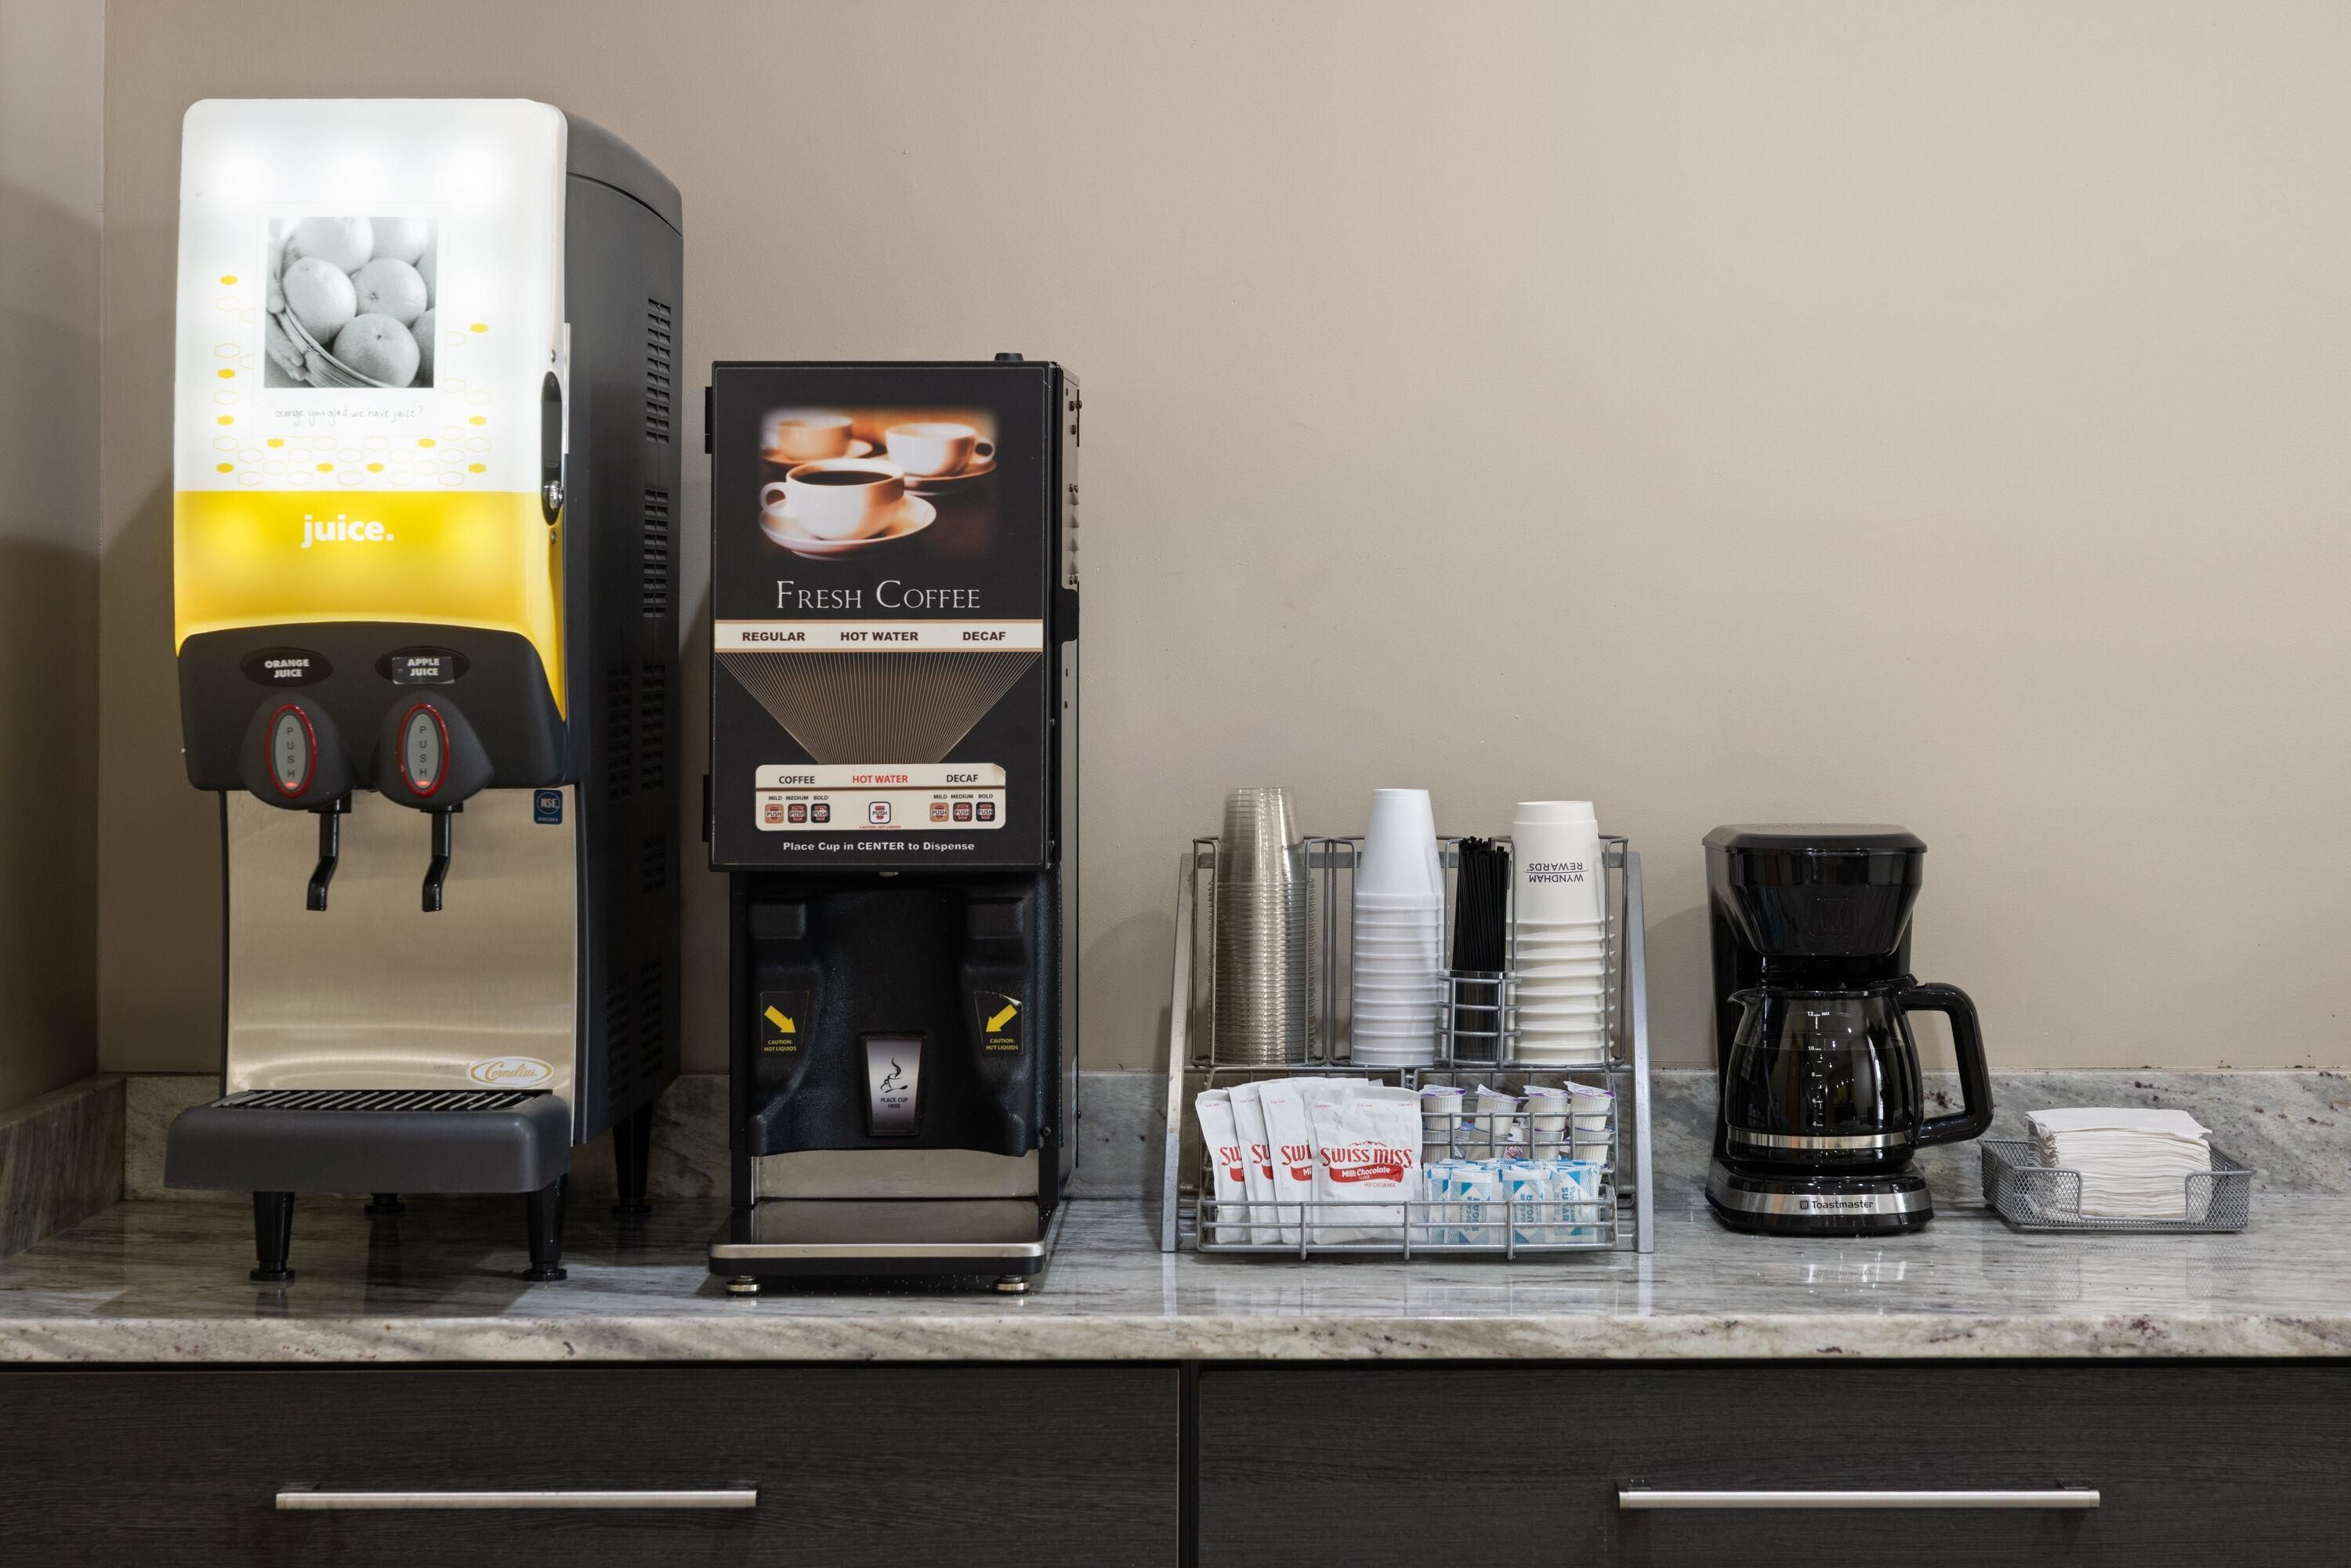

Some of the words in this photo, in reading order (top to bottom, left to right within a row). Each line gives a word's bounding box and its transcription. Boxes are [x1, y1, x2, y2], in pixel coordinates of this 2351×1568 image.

[308, 409, 325, 427] you
[301, 513, 395, 549] juice.
[777, 581, 862, 609] FRESH
[876, 580, 980, 609] COFFEE
[742, 632, 806, 642] REGULAR
[840, 632, 868, 642] HOT
[872, 632, 919, 642] WATER
[962, 632, 1006, 641] DECAF
[264, 658, 310, 668] ORANGE
[408, 657, 440, 667] APPLE
[273, 669, 303, 678] JUICE
[410, 668, 439, 676] JUICE
[286, 726, 295, 778] PUSH
[418, 726, 427, 777] PUSH
[778, 776, 816, 784] COFFEE
[852, 775, 873, 784] HOT
[875, 775, 908, 784] WATER
[946, 774, 979, 783] DECAF
[541, 797, 557, 808] NSF
[784, 842, 814, 851] Place
[818, 842, 840, 852] Cup
[857, 842, 904, 850] CENTER
[923, 842, 975, 852] Dispense
[1528, 862, 1583, 871] REWARDS
[1529, 874, 1584, 883] WYNDHAM
[484, 1061, 538, 1081] Cornelius
[1357, 1166, 1391, 1177] Chocolate
[1811, 1200, 1874, 1209] Toastmaster
